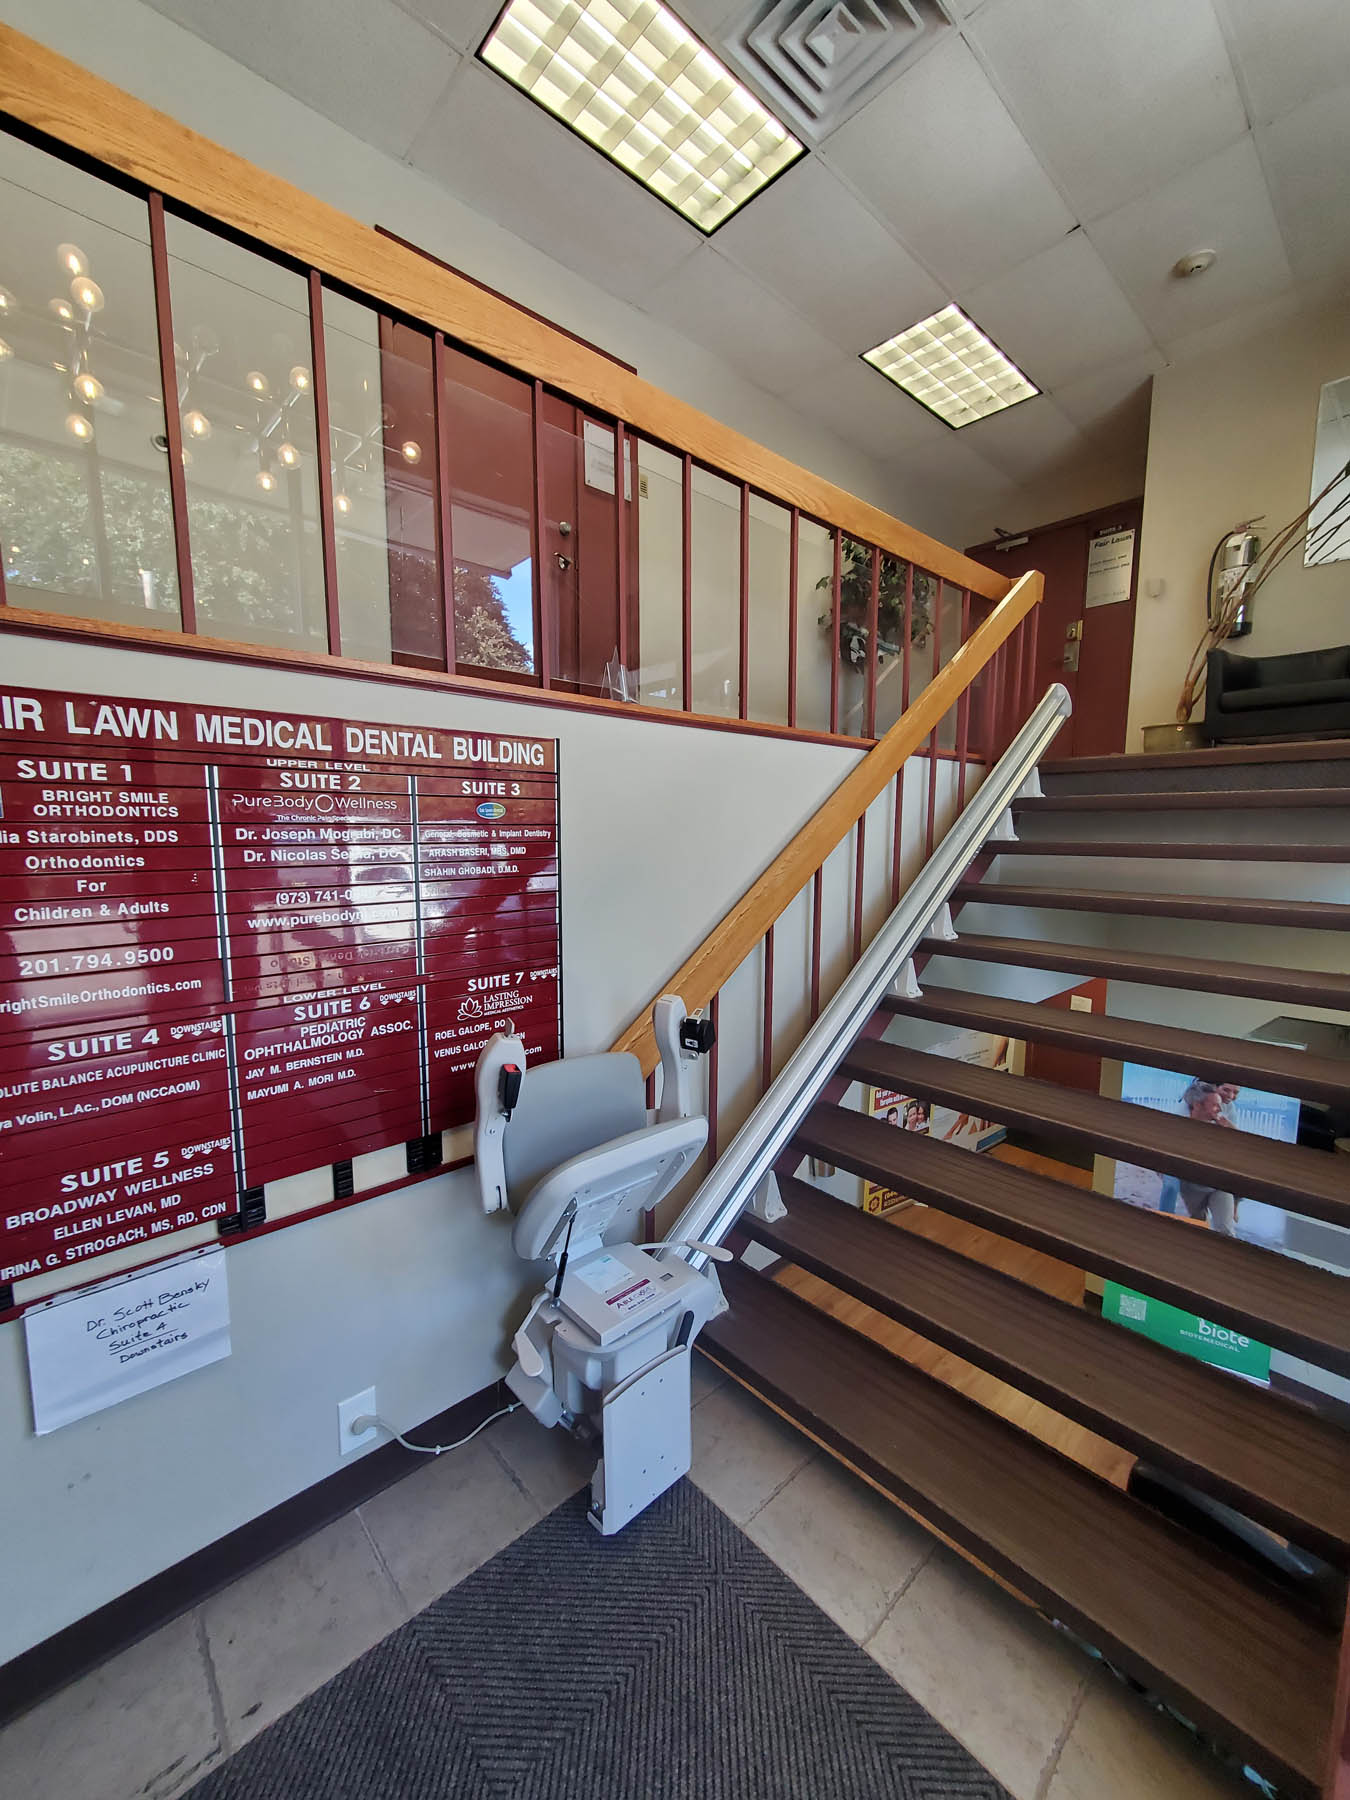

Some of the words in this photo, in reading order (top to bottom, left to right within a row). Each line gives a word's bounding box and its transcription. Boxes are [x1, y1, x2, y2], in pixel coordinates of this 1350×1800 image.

[0, 696, 46, 732] IR
[65, 701, 179, 741] LAWN
[195, 713, 332, 751] MEDICAL
[345, 727, 442, 759] DENTAL
[453, 738, 545, 766] BUILDING
[17, 759, 108, 781] SUITE
[120, 764, 133, 782] 1
[266, 758, 318, 770] UPPER
[325, 761, 371, 772] LEVEL
[280, 772, 341, 790] SUITE
[348, 775, 361, 790] 2
[461, 781, 506, 795] SUITE
[511, 783, 521, 796] 3
[42, 790, 113, 803] BRIGHT
[119, 791, 169, 804] SMILE
[33, 804, 179, 817] ORTHODONTICS
[291, 814, 317, 822] Chronic
[27, 830, 139, 845] Starobinets,
[144, 830, 179, 843] DDS
[235, 828, 258, 840] Dr.
[261, 828, 316, 844] Joseph
[382, 828, 401, 839] DC
[499, 830, 522, 839] Implant
[524, 830, 552, 839] Dentistry
[25, 854, 145, 869] Orthodontics
[243, 850, 266, 862] Dr.
[270, 849, 327, 862] Nicolas
[459, 847, 490, 857] BASERI,
[510, 846, 527, 855] DMD
[424, 867, 457, 877] SHAHIN
[498, 865, 520, 874] D.M.D.
[76, 879, 107, 893] For
[275, 892, 311, 906] (973)
[14, 906, 93, 921] Children
[100, 904, 111, 916] &
[117, 901, 170, 915] Adults
[19, 946, 174, 976] 201.794.9500
[467, 973, 511, 992] SUITE
[514, 971, 525, 984] 7
[283, 988, 337, 1004] LOWER
[343, 982, 387, 995] LEVEL
[483, 990, 520, 1003] LASTING
[483, 995, 533, 1011] IMPRESSION
[294, 998, 352, 1021] SUITE
[359, 996, 371, 1011] 6
[379, 989, 417, 1002] DOWNSTAIRS
[300, 1016, 366, 1038] PEDIATRIC
[434, 1030, 457, 1041] ROEL
[458, 1022, 492, 1036] GALOPE,
[494, 1019, 506, 1029] DO
[48, 1032, 133, 1061] SUITE
[141, 1028, 160, 1045] 4
[170, 1020, 222, 1036] DOWNSTAIRS
[243, 1028, 364, 1061] OPHTHALMOLOGY
[370, 1020, 414, 1037] ASSOC.
[434, 1045, 461, 1058] VENUS
[41, 1070, 104, 1091] BALANCE
[106, 1055, 190, 1079] ACUPUNCTURE
[191, 1048, 226, 1063] CLINIC
[245, 1067, 265, 1080] JAY
[269, 1064, 282, 1075] M.
[286, 1050, 342, 1071] BERNSTEIN
[345, 1047, 365, 1059] M.D.
[247, 1083, 289, 1101] MAYUMI
[293, 1080, 304, 1090] A.
[308, 1073, 334, 1087] MORI
[337, 1068, 357, 1080] M.D.
[16, 1109, 58, 1127] Volin,
[59, 1103, 99, 1118] L.Ac.,
[101, 1094, 134, 1109] DOM
[137, 1079, 201, 1103] (NCCAOM)
[61, 1157, 143, 1192] SUITE
[152, 1151, 170, 1168] 5
[181, 1136, 231, 1156] DOWNSTAIRS
[6, 1188, 118, 1230] BROADWAY
[124, 1163, 214, 1196] WELLNESS
[53, 1216, 103, 1240] ELLEN
[107, 1202, 157, 1225] LEVAN,
[160, 1194, 182, 1209] MD
[0, 1259, 41, 1281] IRINA
[45, 1253, 61, 1266] G.
[66, 1226, 148, 1260] STROGACH,
[151, 1217, 174, 1234] MS,
[177, 1211, 198, 1226] RD,
[201, 1202, 227, 1218] CDN
[86, 1318, 105, 1332] Dr.
[113, 1298, 154, 1321] Scott
[158, 1278, 210, 1305] Bensky
[96, 1301, 191, 1340] Chiropractic
[1197, 1317, 1249, 1348] biote
[119, 1331, 188, 1363] Downstairs
